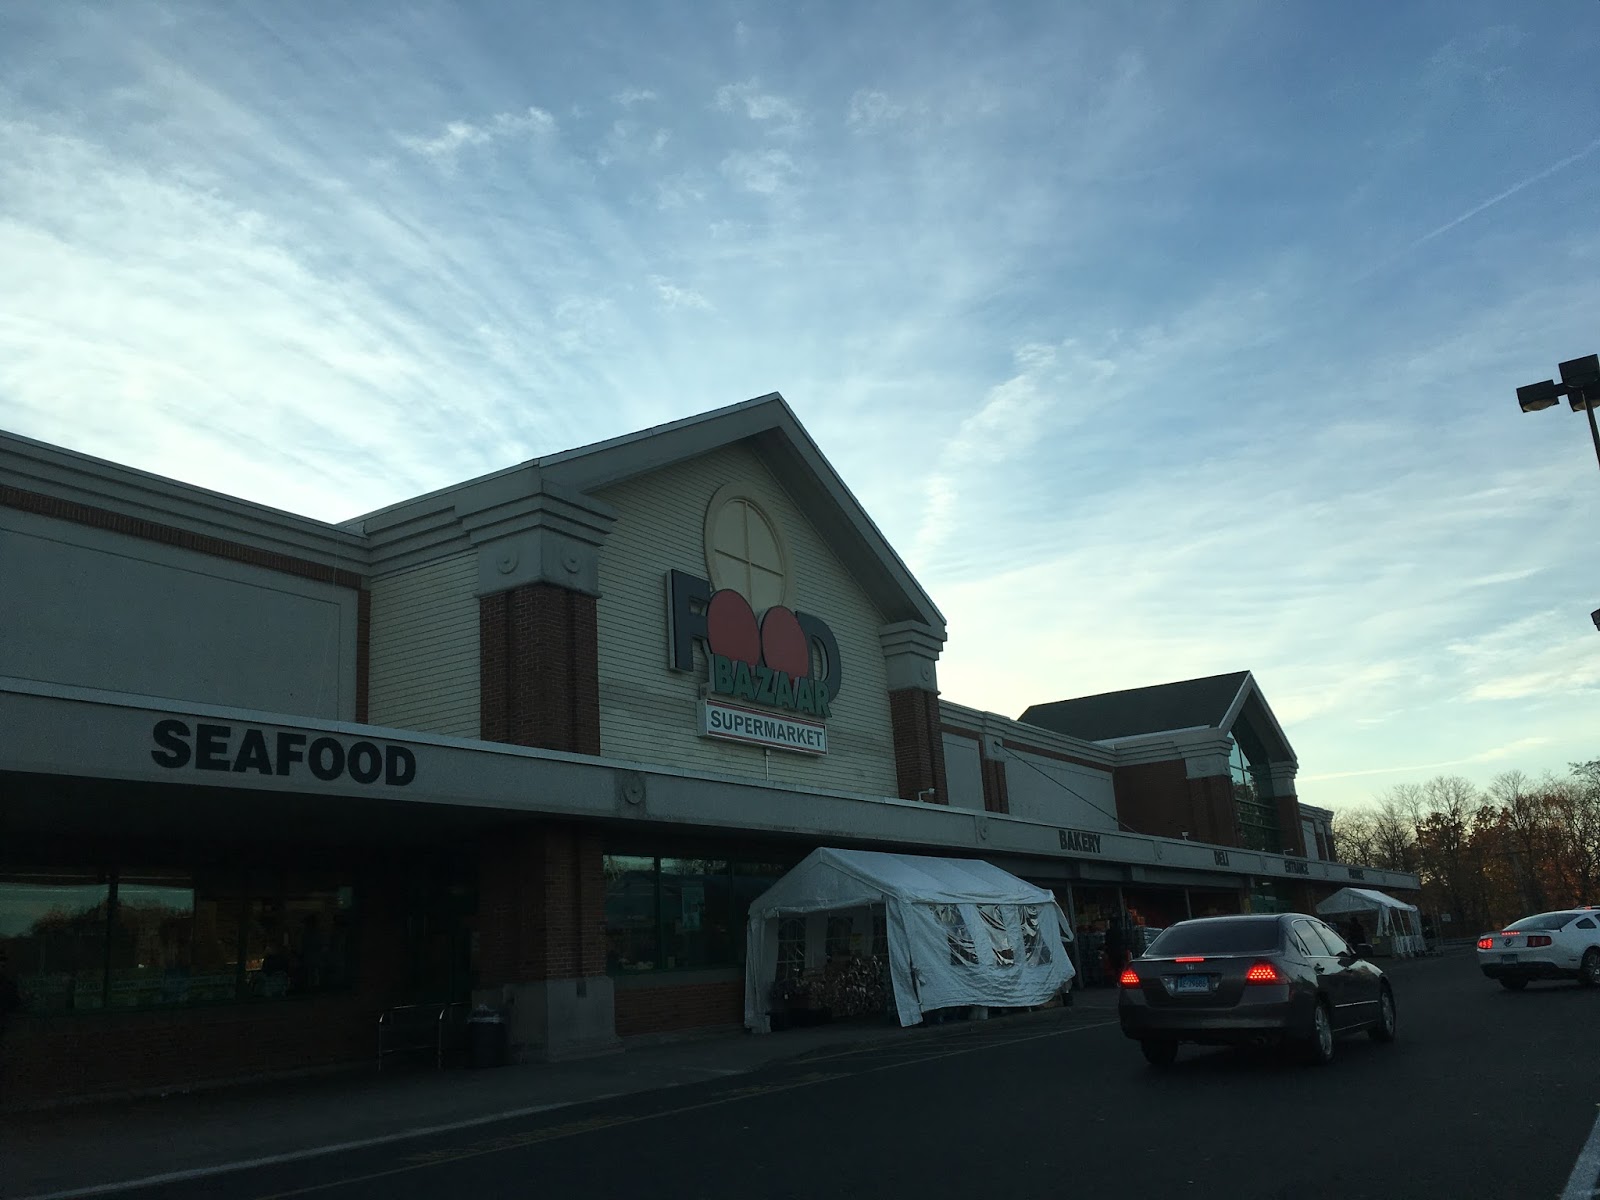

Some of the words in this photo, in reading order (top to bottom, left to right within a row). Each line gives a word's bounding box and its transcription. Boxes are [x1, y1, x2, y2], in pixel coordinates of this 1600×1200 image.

[667, 569, 841, 703] FOOD
[713, 655, 832, 717] BAZAAR
[151, 719, 417, 786] SEAFOOD
[711, 711, 823, 747] SUPERMARKET
[1059, 829, 1101, 853] BAKERY
[1214, 851, 1229, 866] DELI
